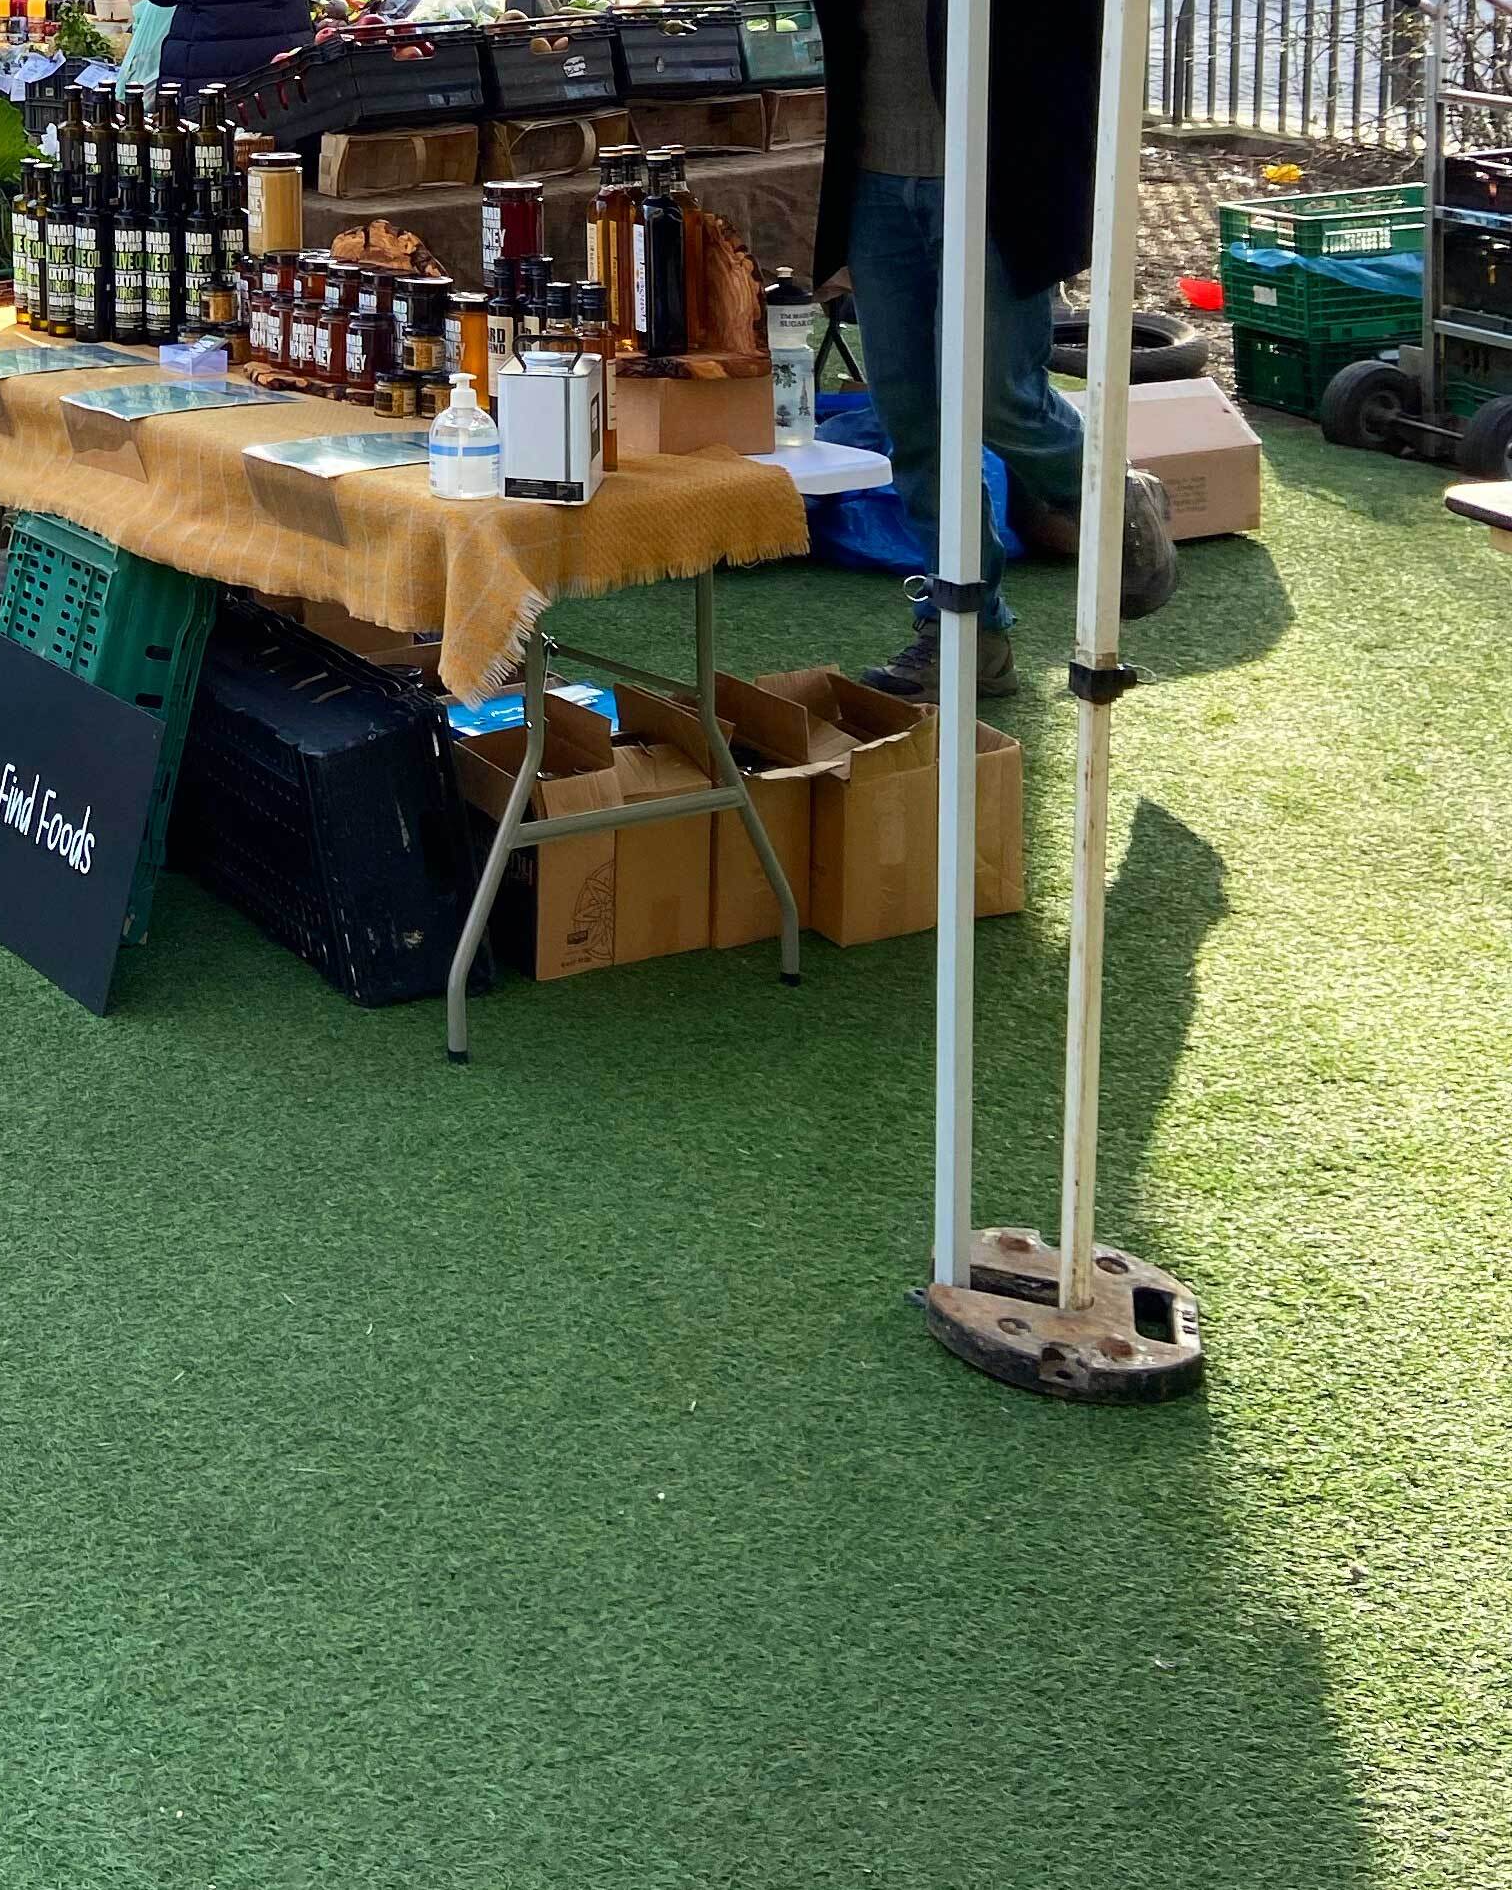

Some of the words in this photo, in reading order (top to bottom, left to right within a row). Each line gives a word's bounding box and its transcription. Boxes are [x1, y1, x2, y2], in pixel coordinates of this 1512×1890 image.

[114, 229, 143, 243] HARD
[489, 328, 506, 343] RD
[36, 790, 95, 874] Foods
